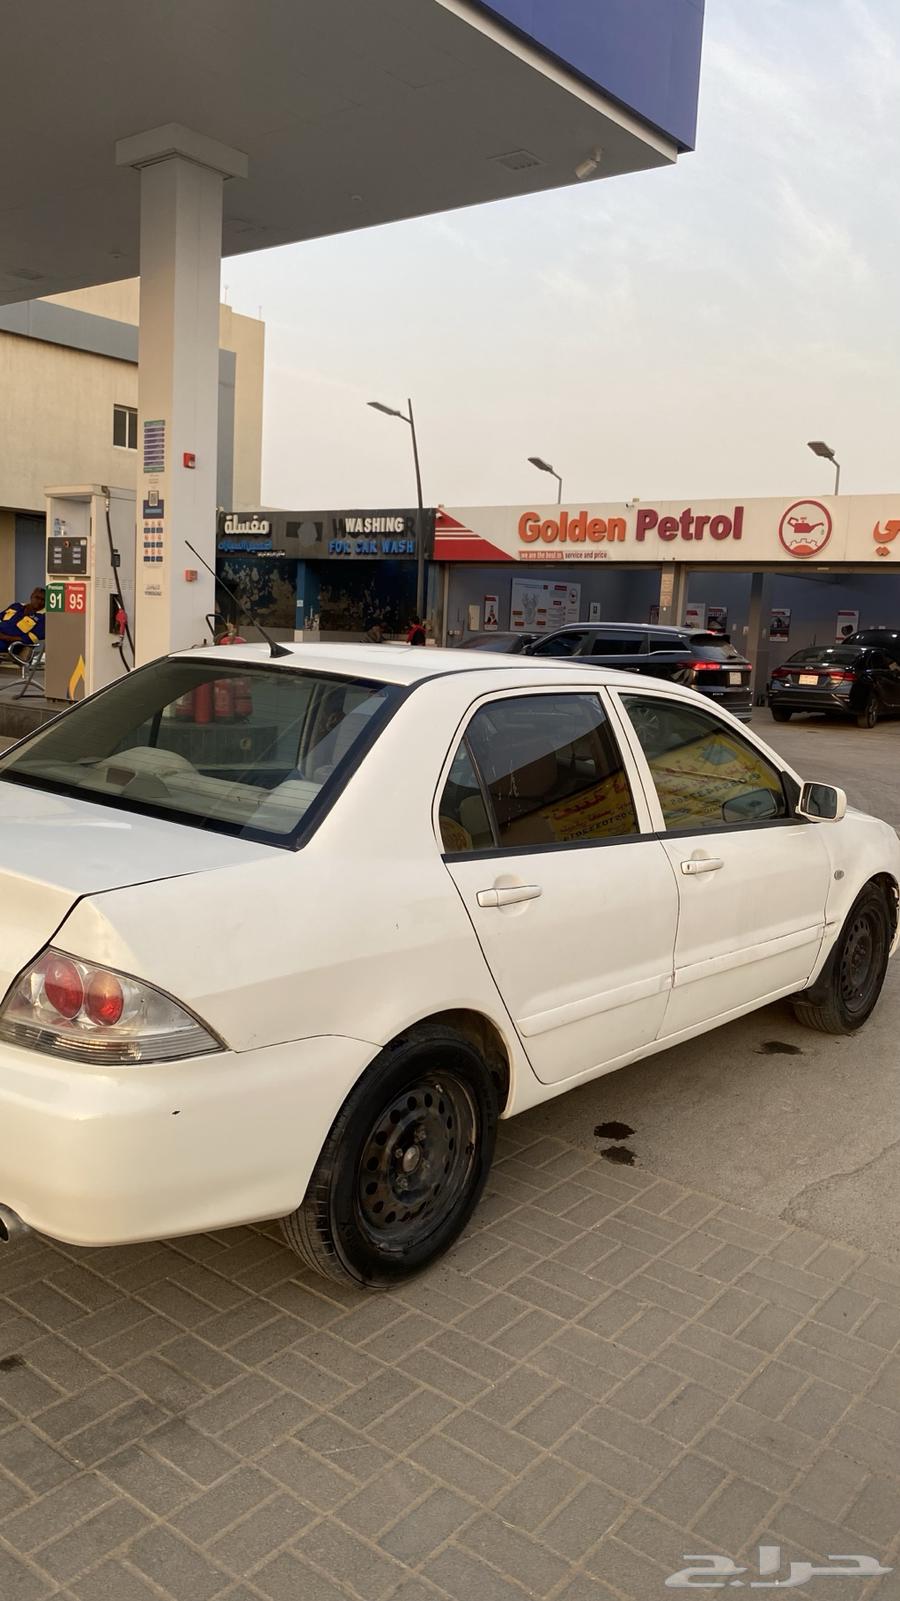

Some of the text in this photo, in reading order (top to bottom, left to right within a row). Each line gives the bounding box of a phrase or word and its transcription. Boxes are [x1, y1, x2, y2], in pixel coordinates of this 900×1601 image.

[224, 514, 270, 534] مغسلة
[345, 517, 404, 533] WASHING
[518, 506, 744, 543] Golden Petrol
[328, 541, 350, 553] FOR
[382, 540, 415, 553] WASH
[565, 551, 582, 559] service
[583, 551, 593, 559] and
[594, 551, 608, 560] price
[49, 593, 62, 609] 91
[69, 593, 84, 610] 95
